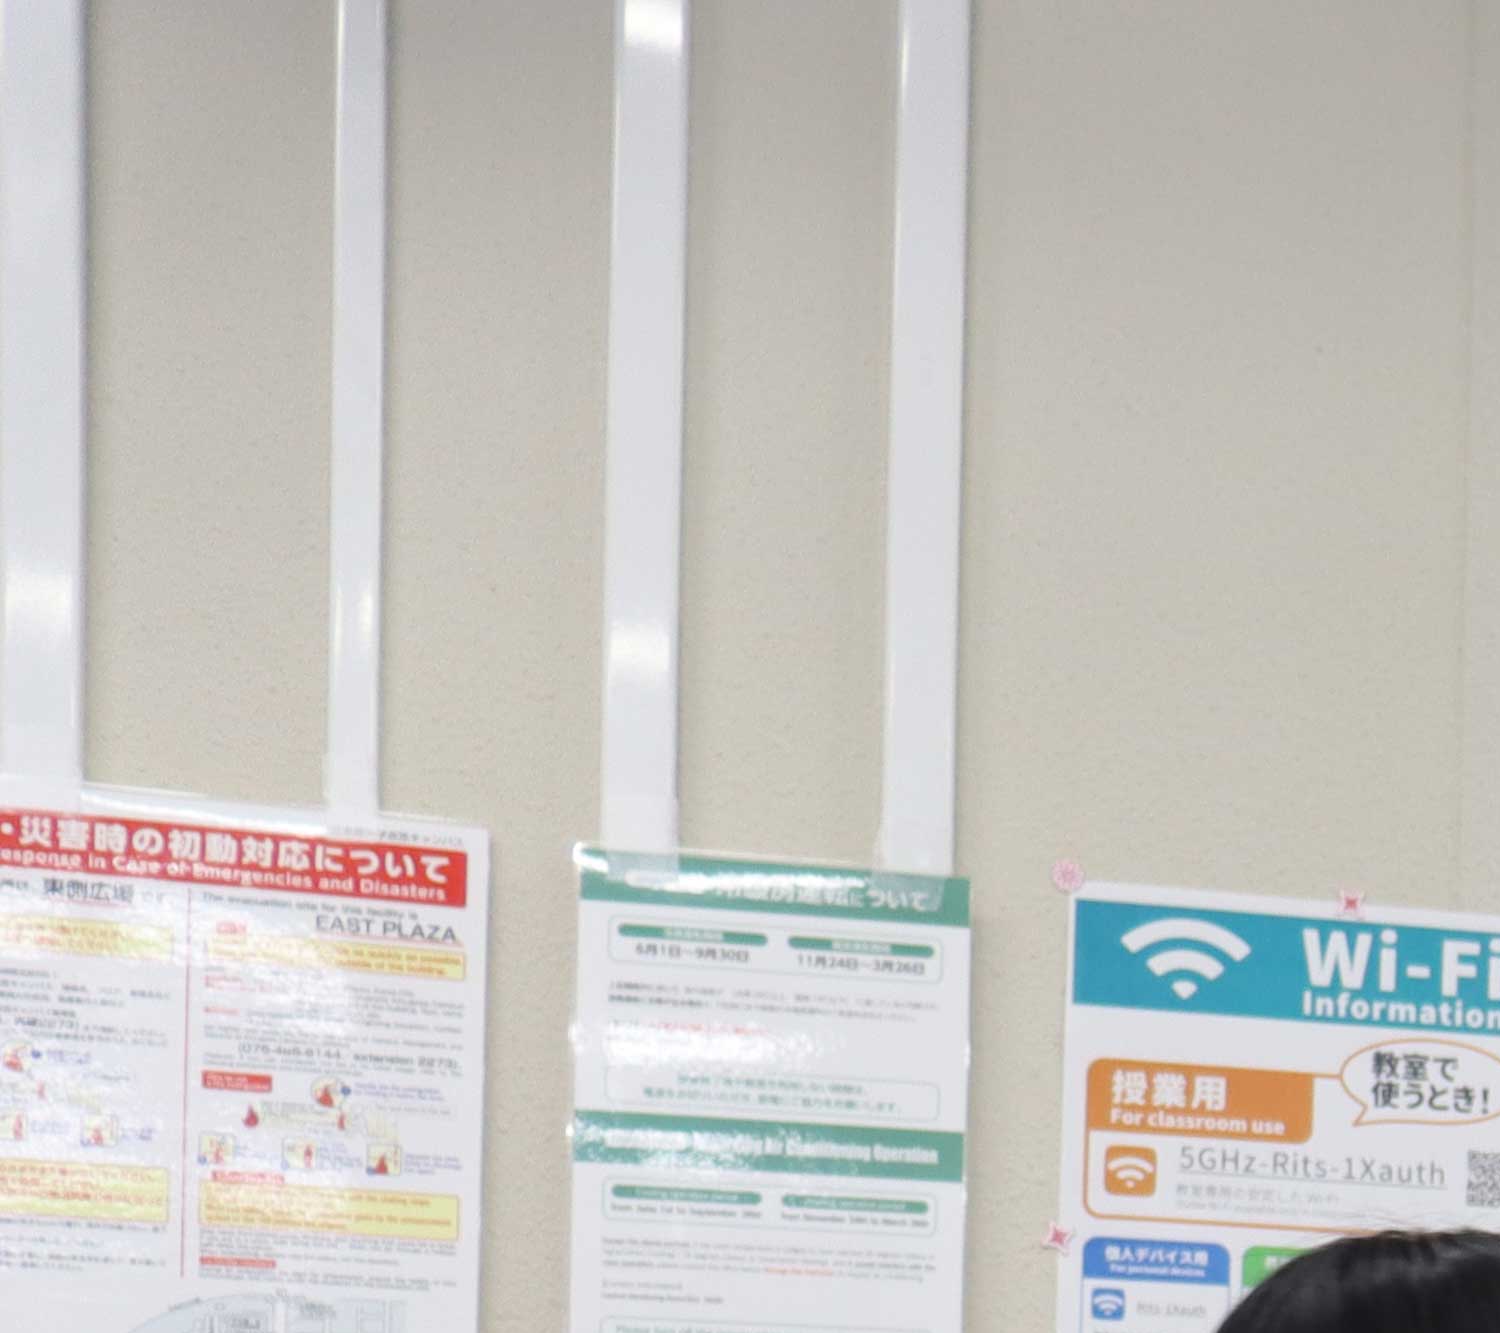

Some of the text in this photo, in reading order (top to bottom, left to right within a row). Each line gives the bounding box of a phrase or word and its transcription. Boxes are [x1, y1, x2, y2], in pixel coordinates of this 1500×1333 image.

[0, 849, 81, 867] esponse
[112, 855, 160, 874] Case
[193, 862, 313, 889] Emergencies
[318, 876, 353, 892] and
[359, 878, 447, 901] Disasters
[315, 913, 458, 942] EAST PLAZA
[1372, 1051, 1459, 1082] 教室で
[1111, 1069, 1228, 1113] 授業用
[1110, 1108, 1285, 1136] For classroom use
[1179, 1145, 1447, 1186] 5GHz-Rits-1Xauth
